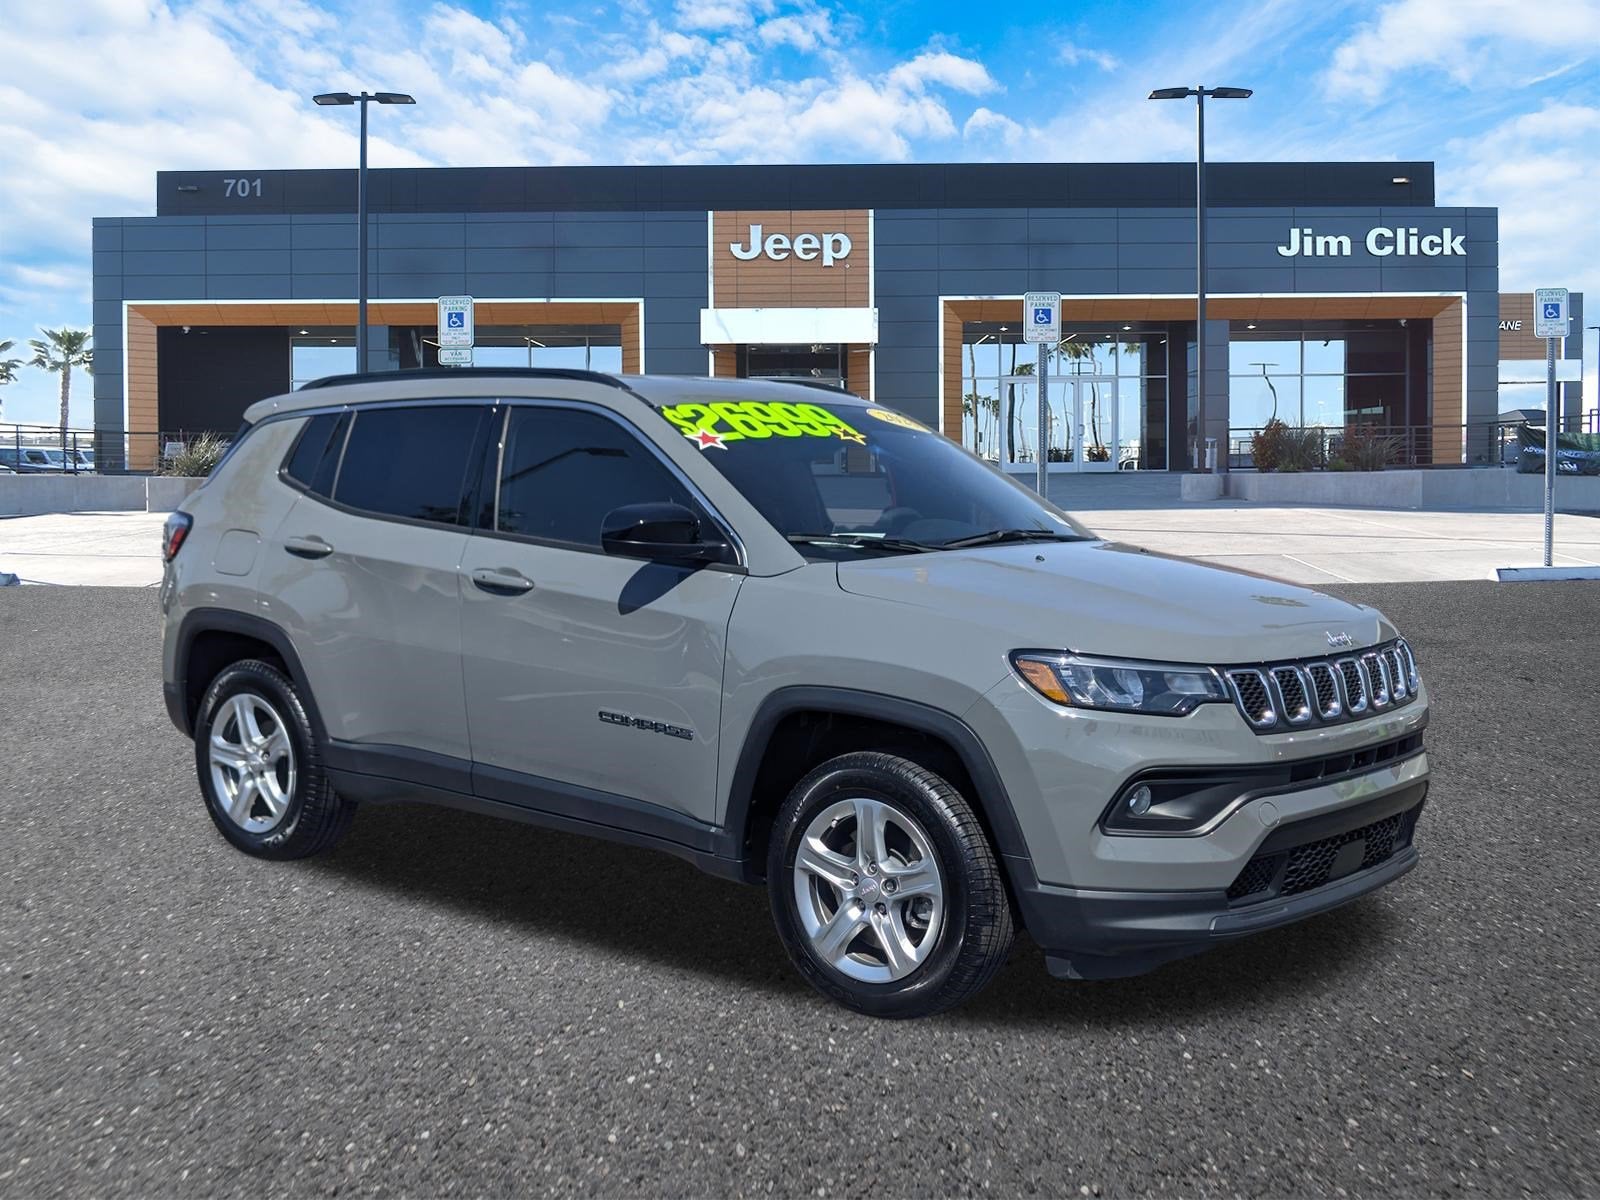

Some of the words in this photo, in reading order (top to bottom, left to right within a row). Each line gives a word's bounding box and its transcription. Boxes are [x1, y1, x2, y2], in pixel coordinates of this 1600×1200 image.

[223, 178, 261, 197] 701
[730, 224, 852, 267] Jeep
[1277, 228, 1351, 257] Jim
[1366, 227, 1467, 256] Click
[661, 401, 858, 440] $26999
[1326, 631, 1352, 647] Jeep
[599, 711, 694, 741] COMPASS
